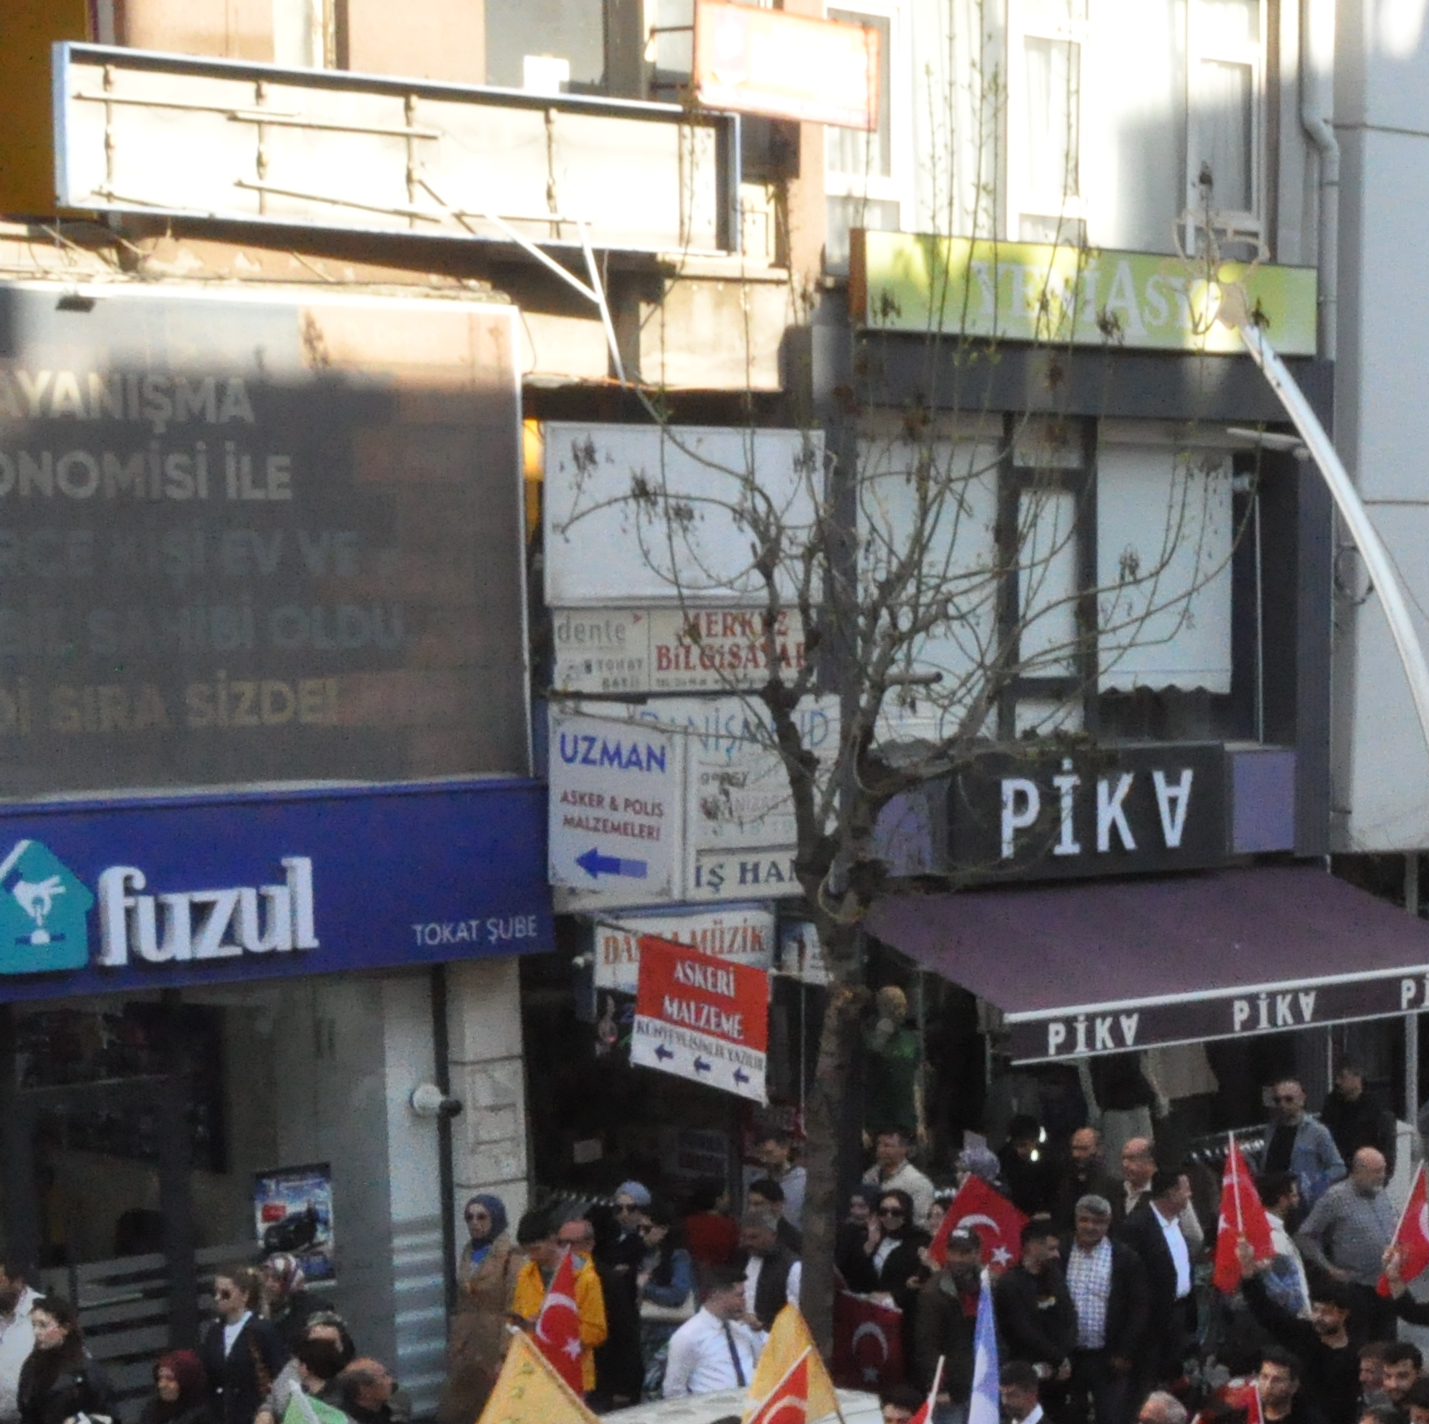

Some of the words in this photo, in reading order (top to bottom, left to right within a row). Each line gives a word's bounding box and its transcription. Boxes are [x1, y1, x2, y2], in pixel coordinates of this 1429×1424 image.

[559, 731, 667, 774] UZMAN
[97, 856, 320, 967] fuzul
[412, 921, 492, 947] TOKAT
[487, 914, 539, 945] ŞUBE
[663, 994, 745, 1041] MALZEME
